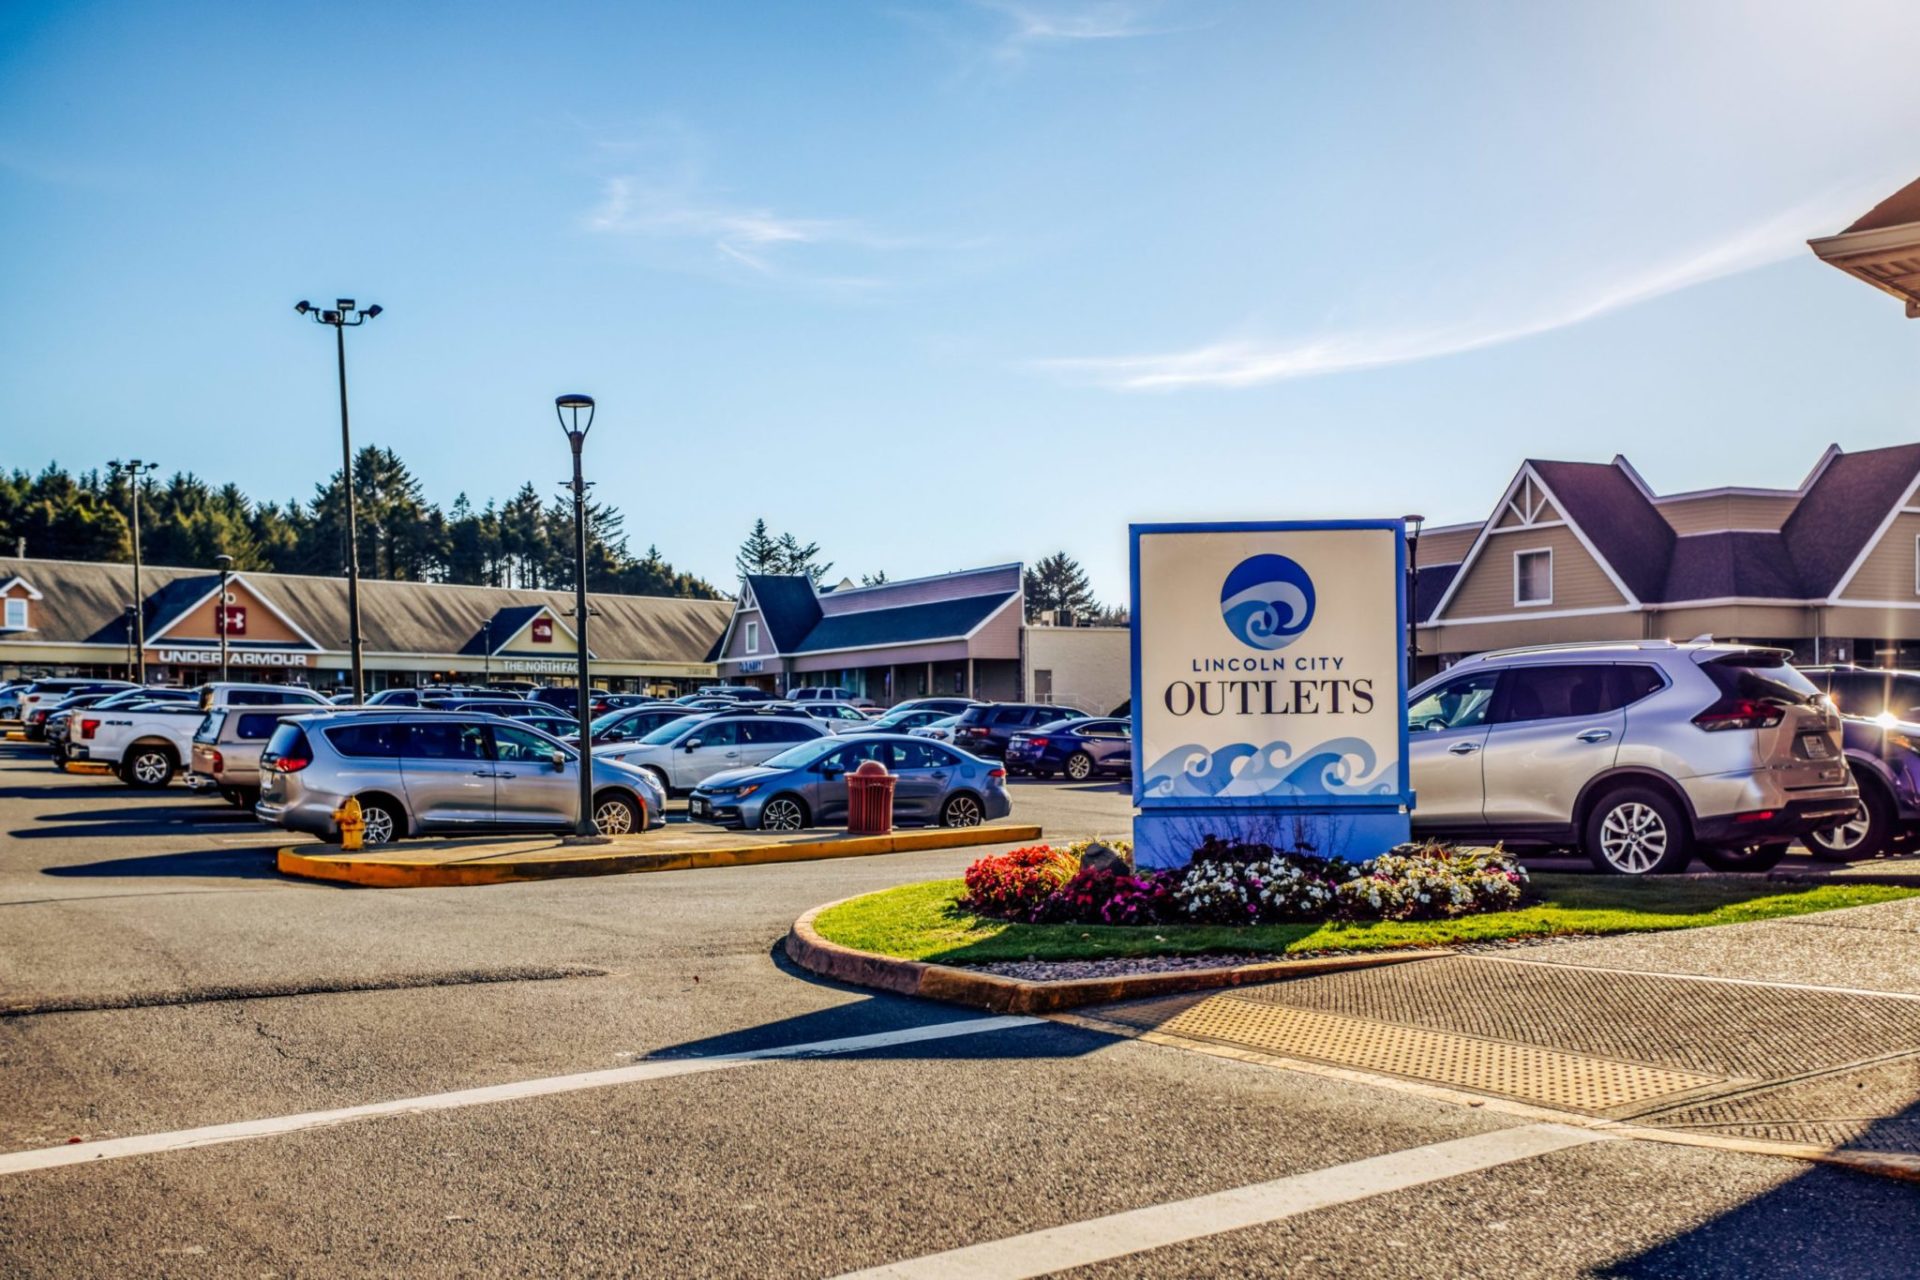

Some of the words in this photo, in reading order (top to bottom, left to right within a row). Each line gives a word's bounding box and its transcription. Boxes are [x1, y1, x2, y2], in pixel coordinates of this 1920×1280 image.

[158, 650, 222, 664] UNDER
[229, 652, 307, 665] ARMOUR
[1192, 657, 1285, 672] LINCOLN
[1295, 656, 1344, 671] CITY
[503, 660, 524, 671] THE
[525, 660, 560, 672] NORTH
[561, 662, 579, 673] FAC
[1164, 678, 1375, 716] OUTLETS
